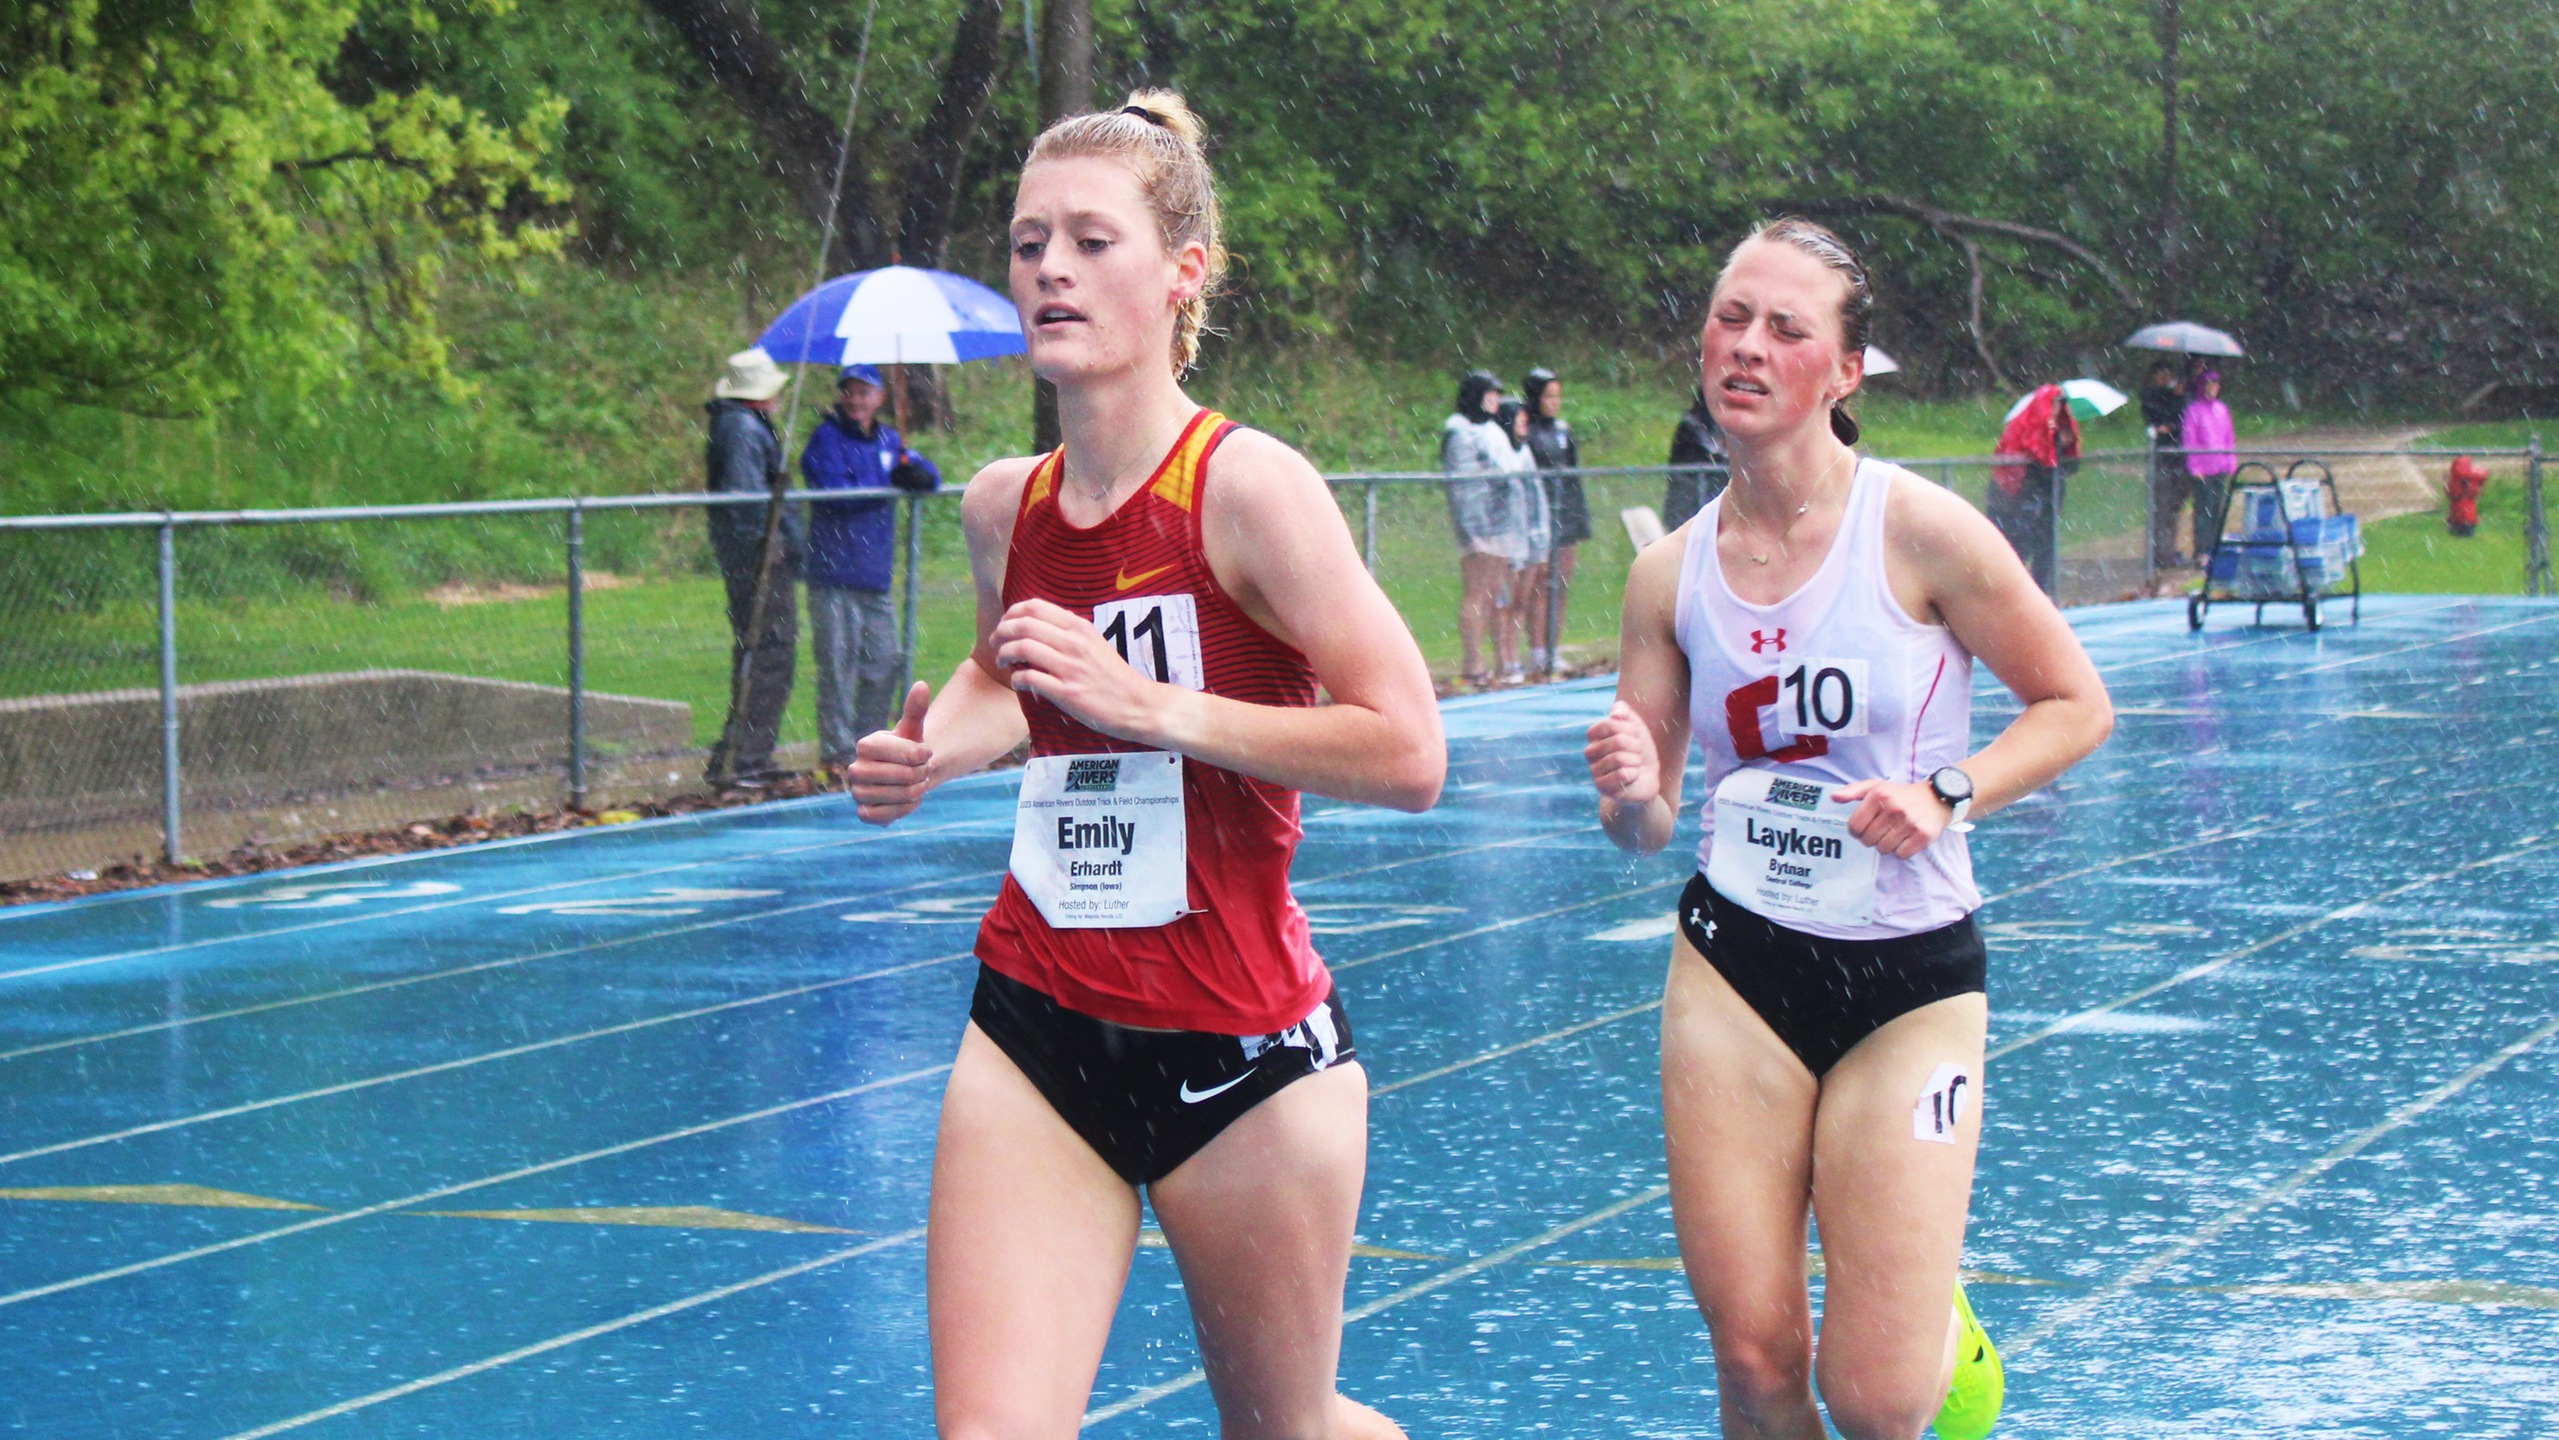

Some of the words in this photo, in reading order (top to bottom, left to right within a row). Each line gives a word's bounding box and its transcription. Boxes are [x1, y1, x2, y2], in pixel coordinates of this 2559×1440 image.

[1102, 605, 1169, 684] 11
[1785, 664, 1853, 731] 10
[1069, 759, 1120, 771] AMERICAN
[1065, 770, 1119, 786] RIVERS
[1770, 778, 1822, 794] AMERICAN
[1033, 800, 1056, 808] American
[1056, 799, 1074, 807] Rivers
[1075, 798, 1096, 807] Outdoor
[1097, 797, 1111, 806] Track
[1113, 797, 1117, 805] &
[1119, 796, 1132, 805] Field
[1134, 796, 1179, 805] Championships
[1058, 815, 1135, 855] Emily
[1747, 817, 1842, 860] Layken
[1070, 860, 1122, 876] Erhardt
[1769, 858, 1812, 877] Bytnar
[1069, 882, 1098, 892] Simpson
[1099, 882, 1122, 892] (Iowa)
[1058, 899, 1086, 910] Hosted
[1089, 899, 1102, 912] by:
[1104, 899, 1129, 910] Luther
